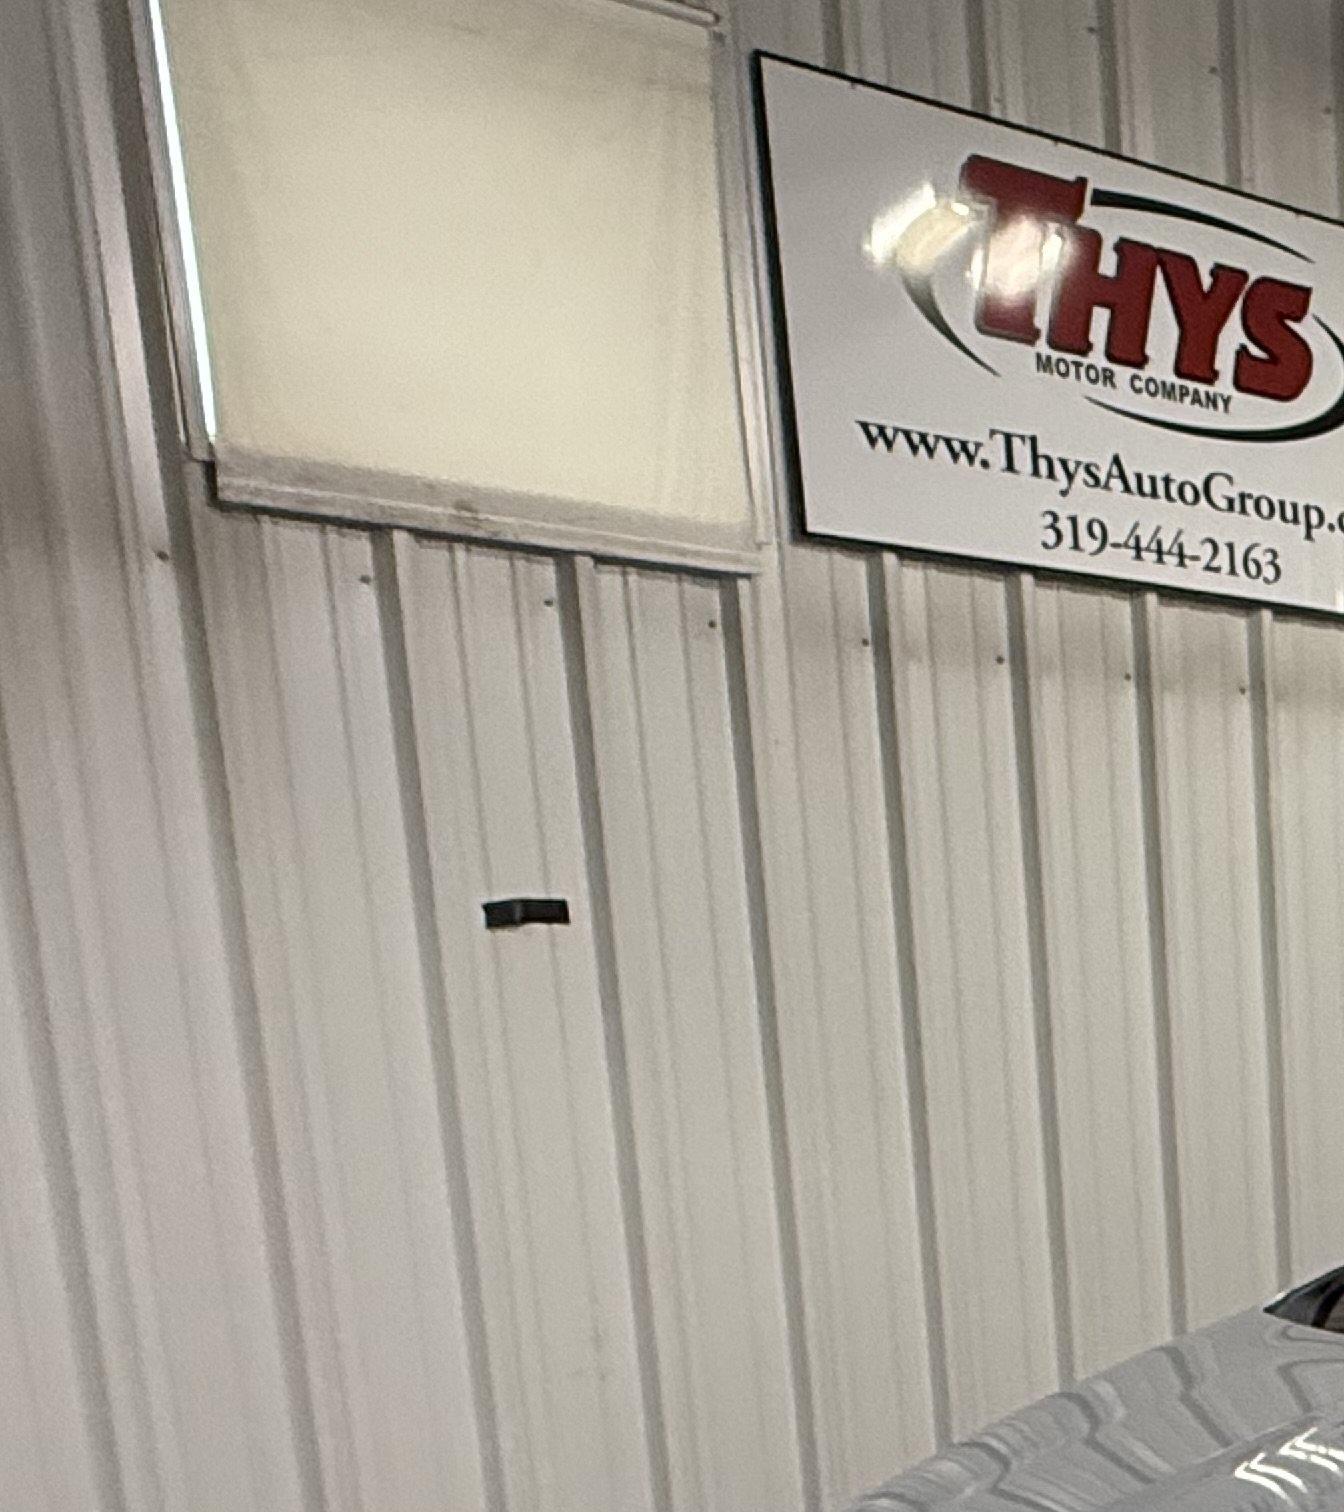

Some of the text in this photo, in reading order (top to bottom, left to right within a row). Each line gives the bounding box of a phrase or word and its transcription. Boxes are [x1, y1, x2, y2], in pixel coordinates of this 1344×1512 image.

[959, 153, 1314, 401] THYS
[1035, 352, 1232, 414] MOTOR COMPANY
[1040, 509, 1283, 586] 319-444-2163
